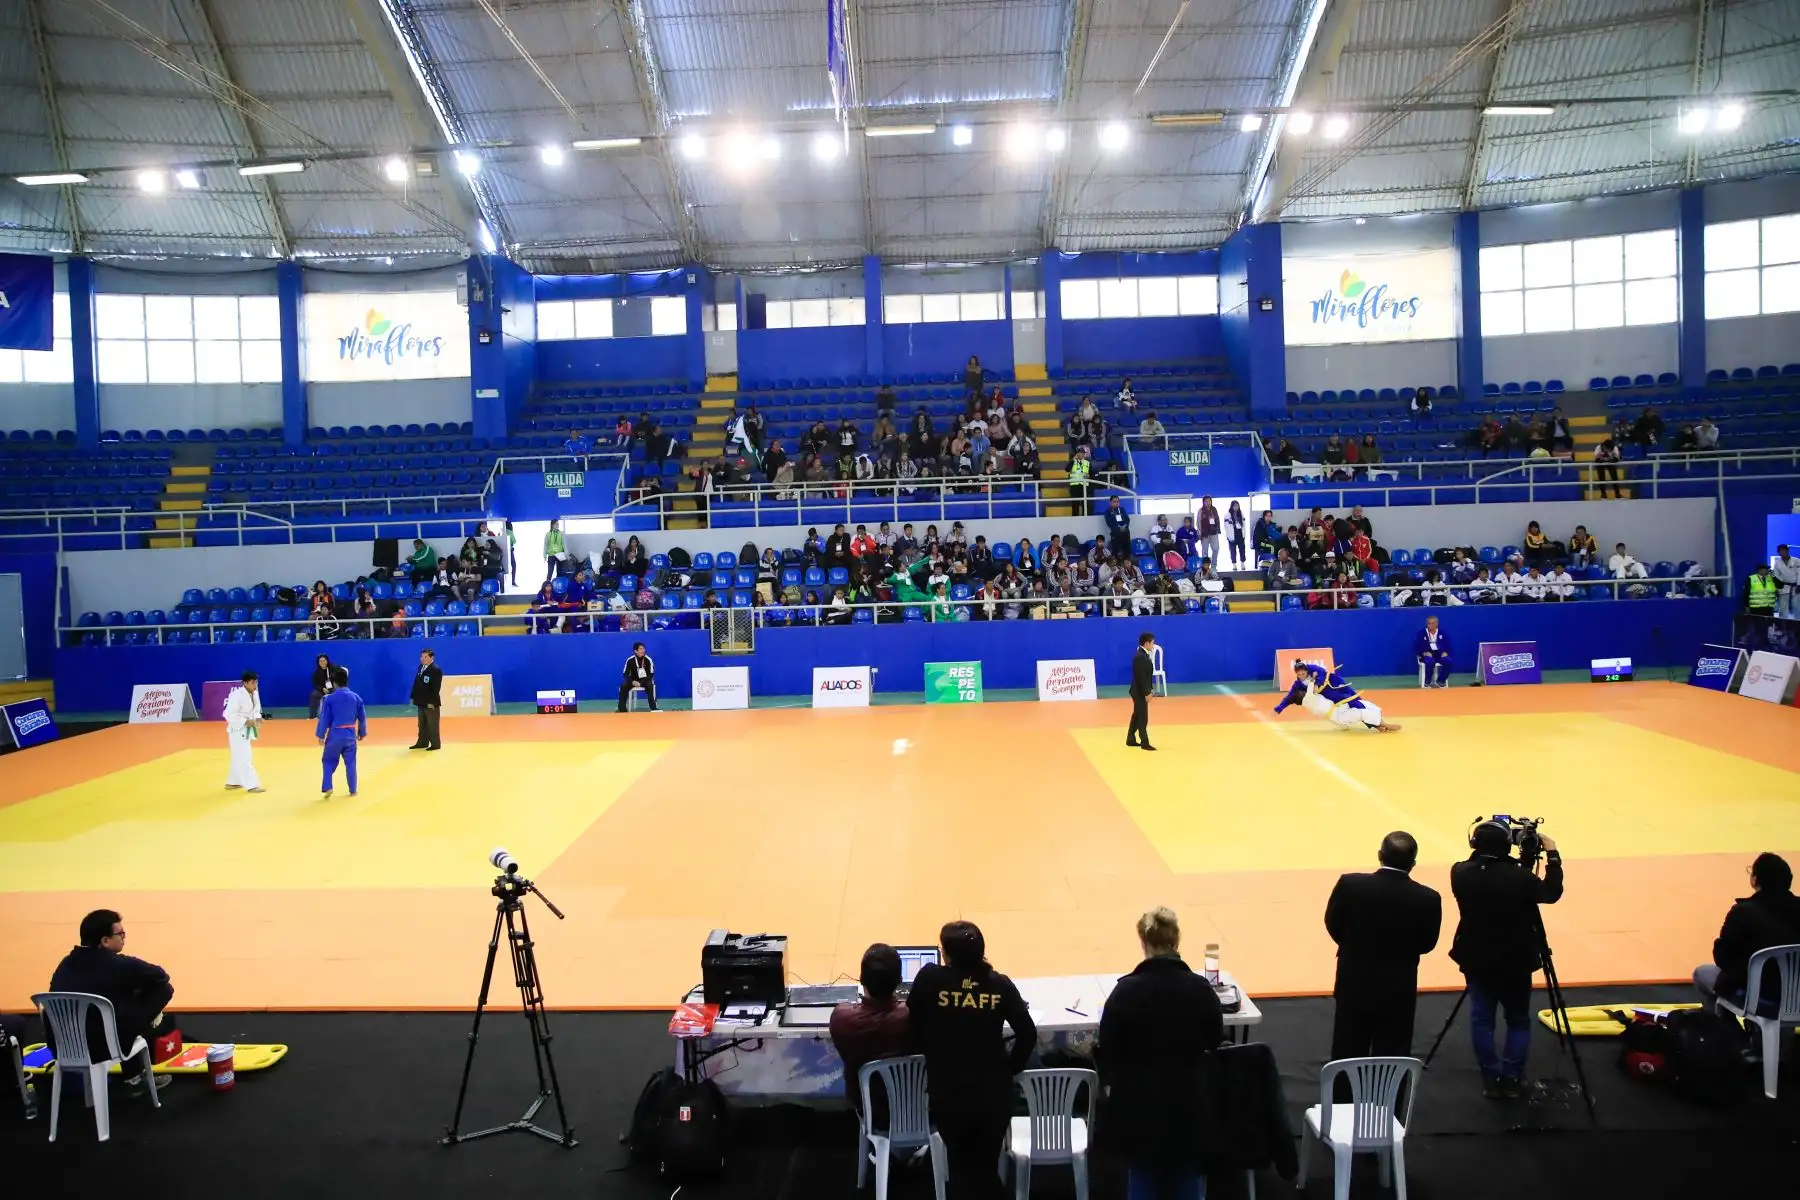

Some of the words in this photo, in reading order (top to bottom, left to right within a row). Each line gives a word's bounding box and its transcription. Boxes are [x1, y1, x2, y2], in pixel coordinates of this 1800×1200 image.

[1309, 284, 1423, 328] Miraflores
[336, 323, 446, 365] Miraflores
[1171, 451, 1209, 464] SALIDA
[546, 474, 583, 486] SALIDA
[949, 667, 974, 678] RES
[820, 679, 862, 691] ALIADOS
[958, 679, 974, 688] PE
[452, 686, 482, 697] AMIS
[958, 691, 976, 701] TO
[938, 991, 1001, 1010] STAFF
